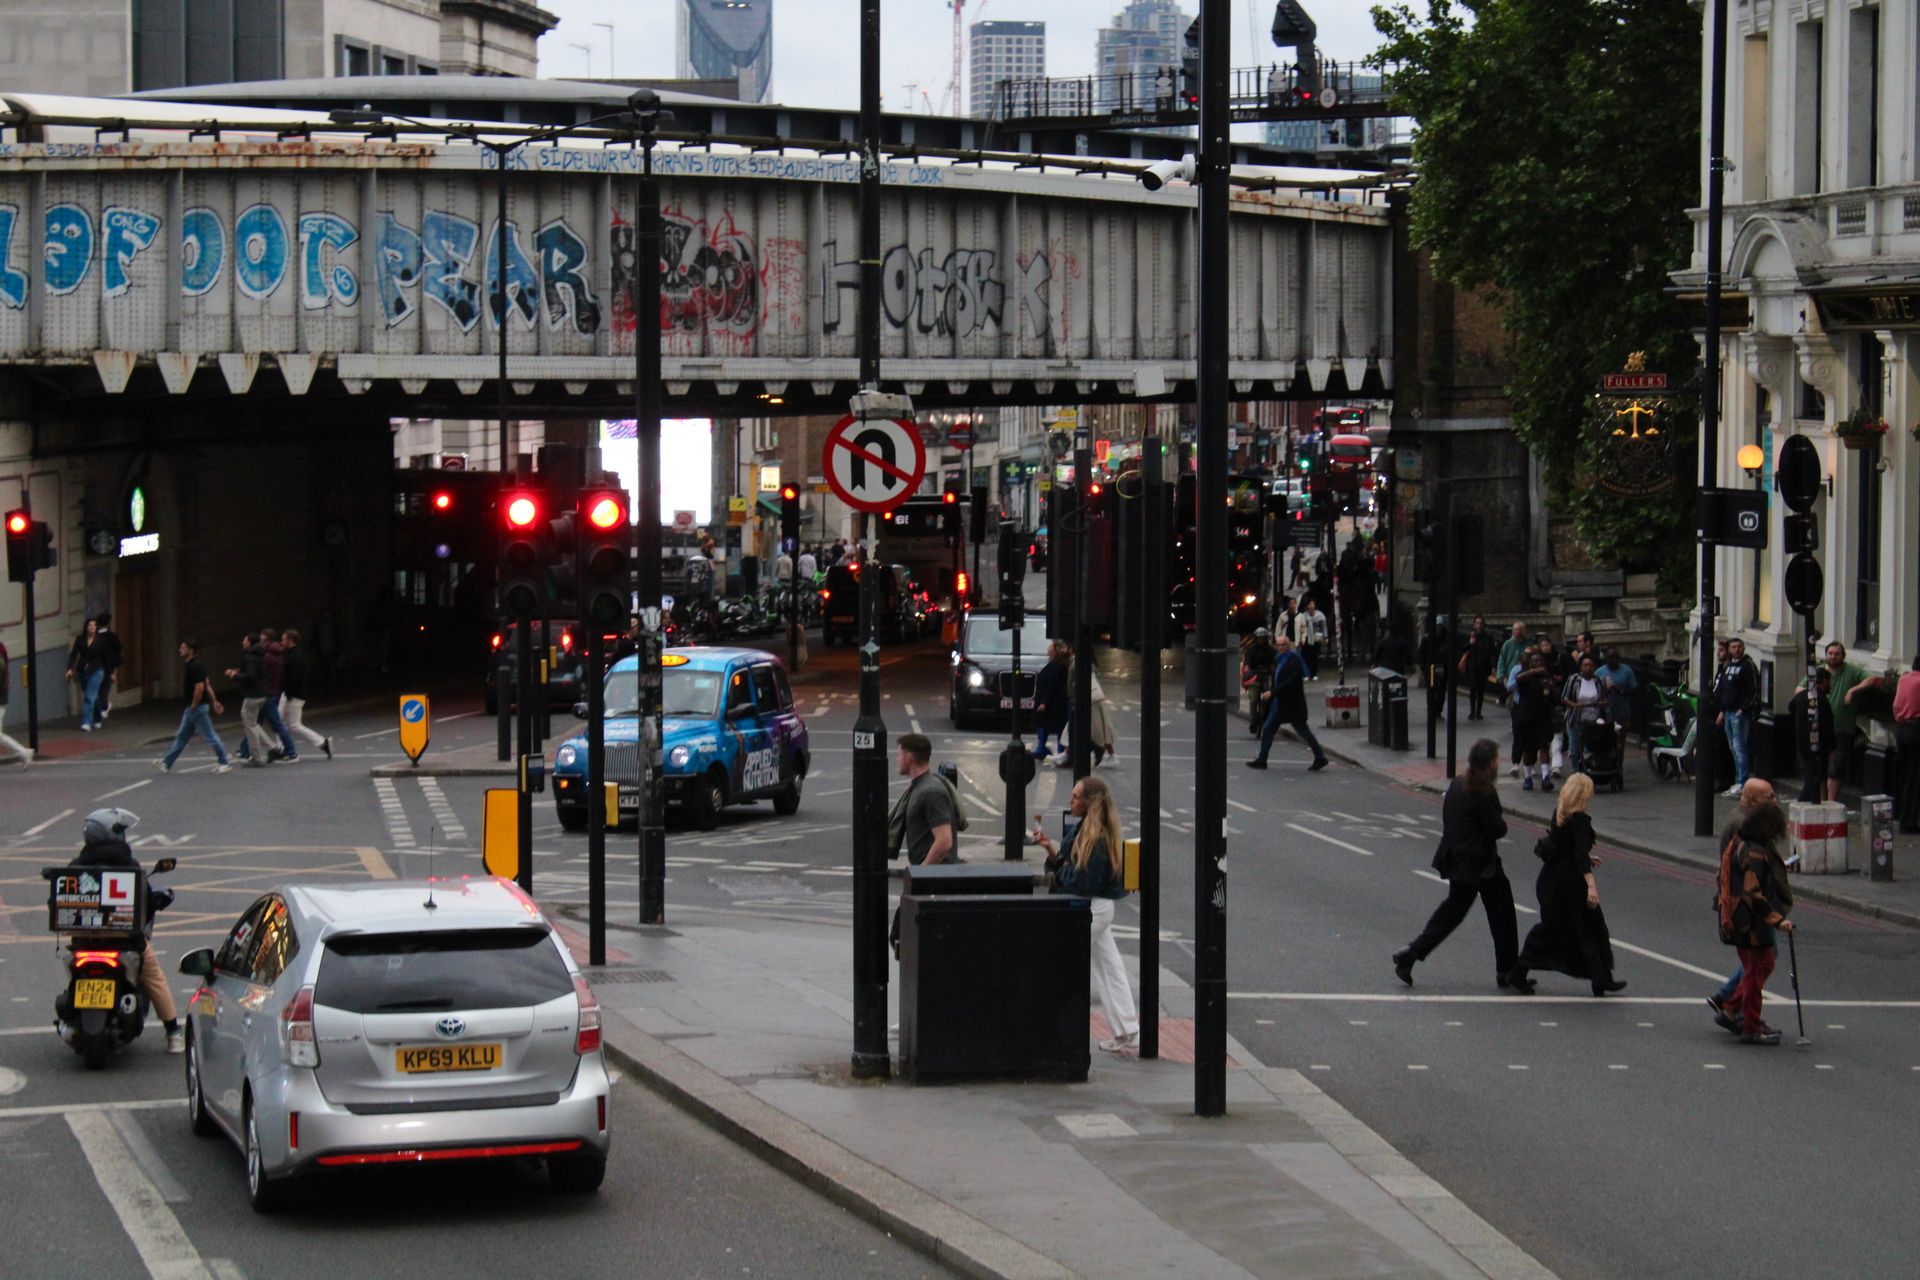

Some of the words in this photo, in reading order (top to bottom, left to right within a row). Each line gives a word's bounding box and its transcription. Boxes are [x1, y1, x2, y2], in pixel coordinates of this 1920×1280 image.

[1870, 296, 1914, 320] THE
[856, 735, 871, 746] 25
[744, 750, 773, 772] APPLIED
[743, 765, 780, 792] NUTRITION
[109, 878, 127, 899] L
[77, 981, 112, 993] EN24
[403, 1048, 453, 1069] KP69
[458, 1045, 495, 1065] KLU
